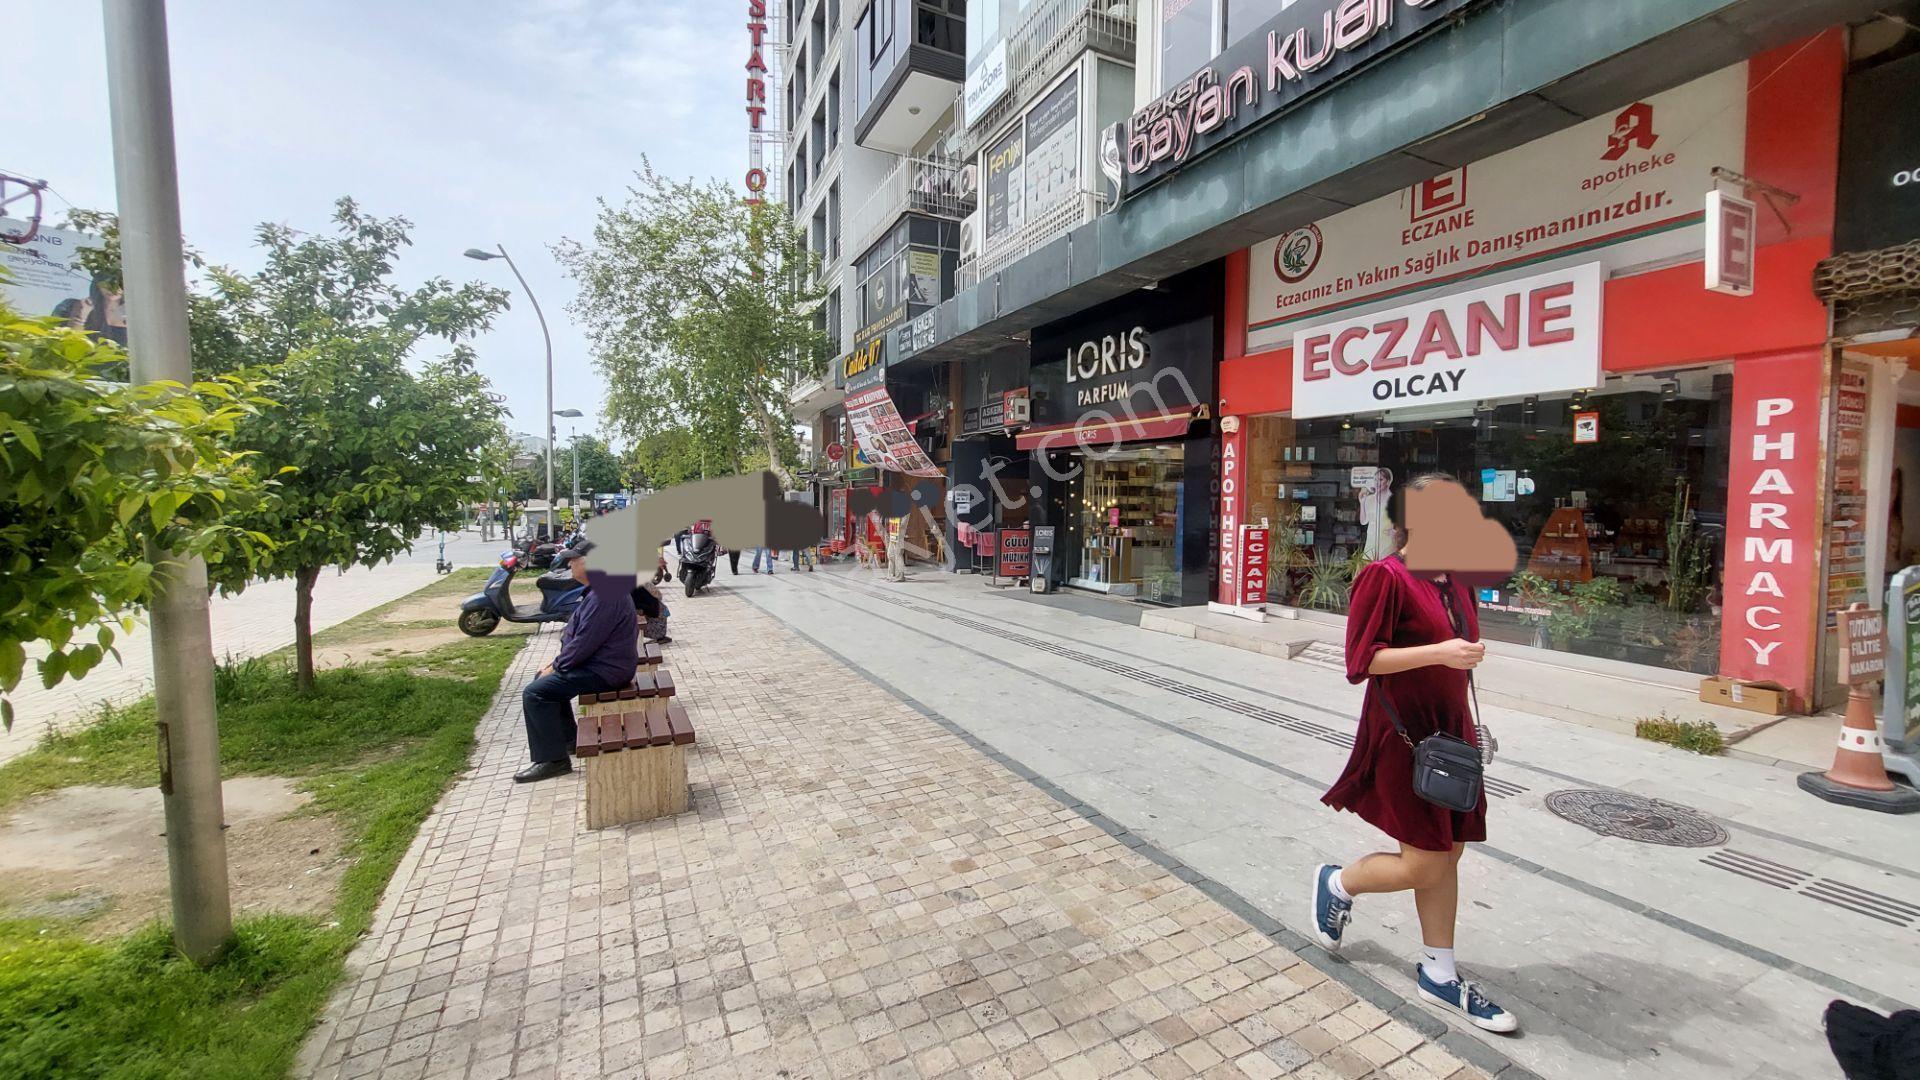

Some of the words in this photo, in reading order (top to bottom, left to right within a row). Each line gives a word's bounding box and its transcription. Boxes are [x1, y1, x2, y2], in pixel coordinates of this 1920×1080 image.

[744, 0, 768, 129] START
[1127, 65, 1258, 175] bayan
[1581, 152, 1676, 191] apotheke
[1276, 283, 1333, 310] Eczacınız
[1336, 277, 1353, 293] En
[1356, 265, 1400, 288] Yakın
[1405, 244, 1460, 275] Sağlık
[1467, 189, 1673, 258] Danışmanınızdır.
[1402, 209, 1474, 246] ECZANE
[1066, 326, 1145, 383] LORIS
[1302, 280, 1576, 382] ECZANE
[1077, 379, 1129, 406] PARFUM
[1372, 369, 1467, 401] OLCAY
[1004, 535, 1029, 548] GÜLÜ
[1221, 442, 1236, 585] APOTHEKE
[1744, 398, 1796, 666] PHARMACY
[1246, 531, 1264, 602] ECZANE
